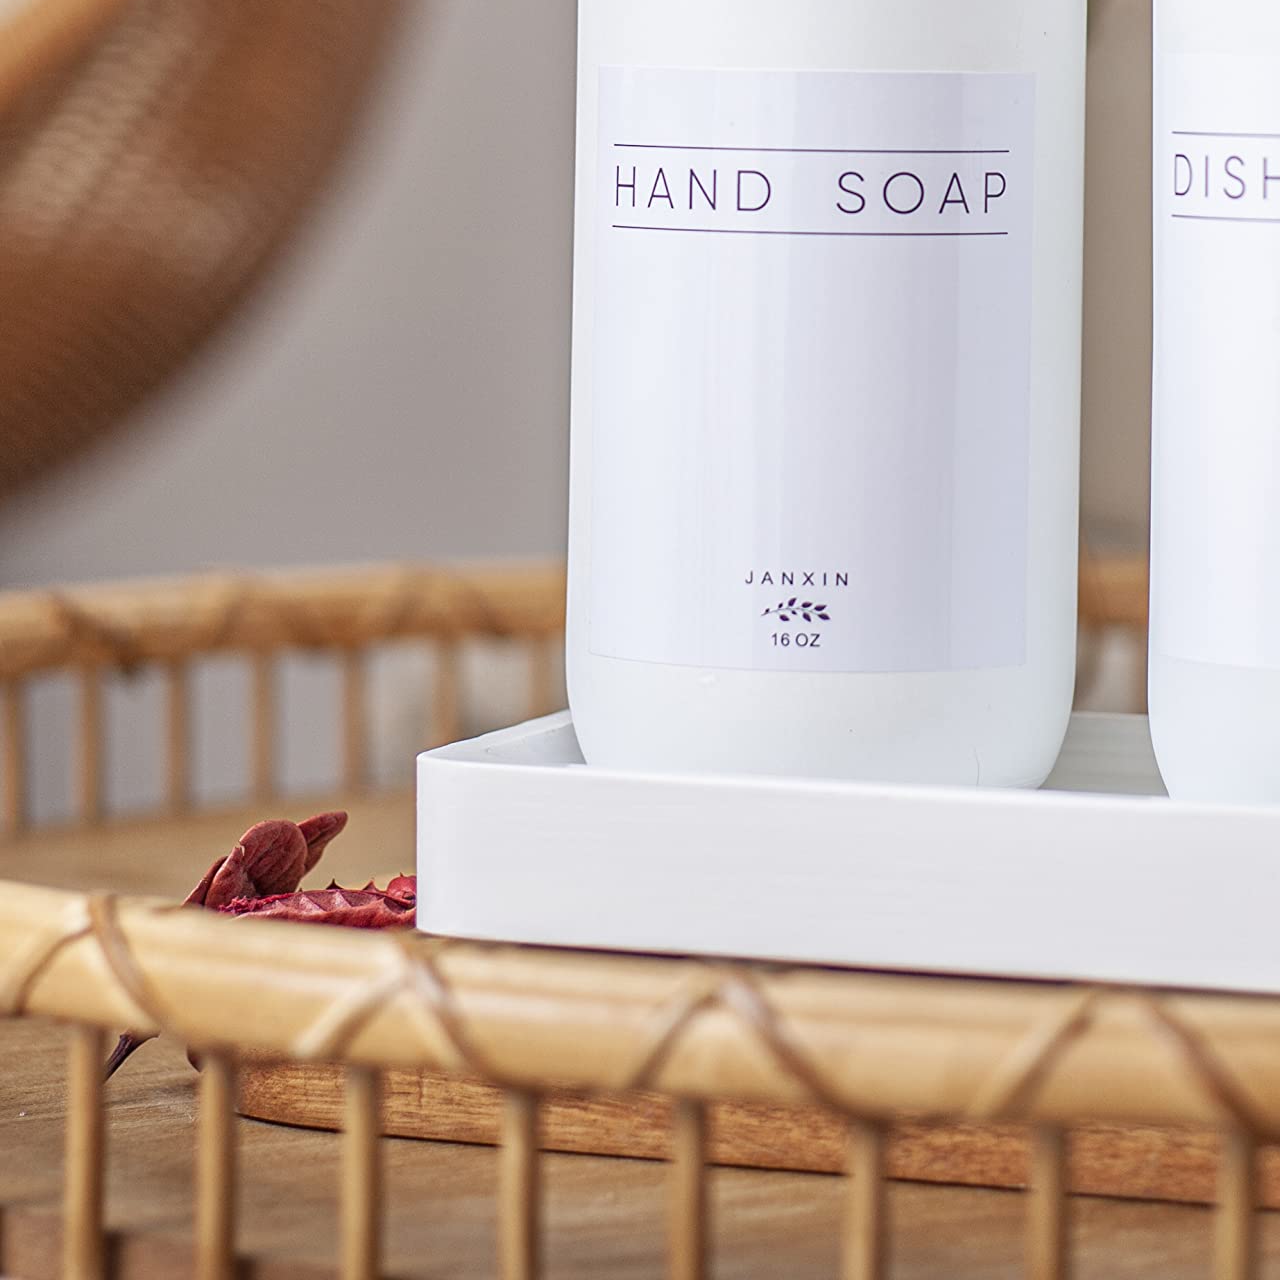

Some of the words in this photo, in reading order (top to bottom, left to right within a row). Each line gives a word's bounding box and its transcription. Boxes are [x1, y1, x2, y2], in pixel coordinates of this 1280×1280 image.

[615, 164, 772, 213] HAND
[835, 170, 1008, 215] SOAP
[744, 570, 849, 587] JANXIN
[771, 632, 791, 648] 16
[795, 632, 821, 648] OZ
